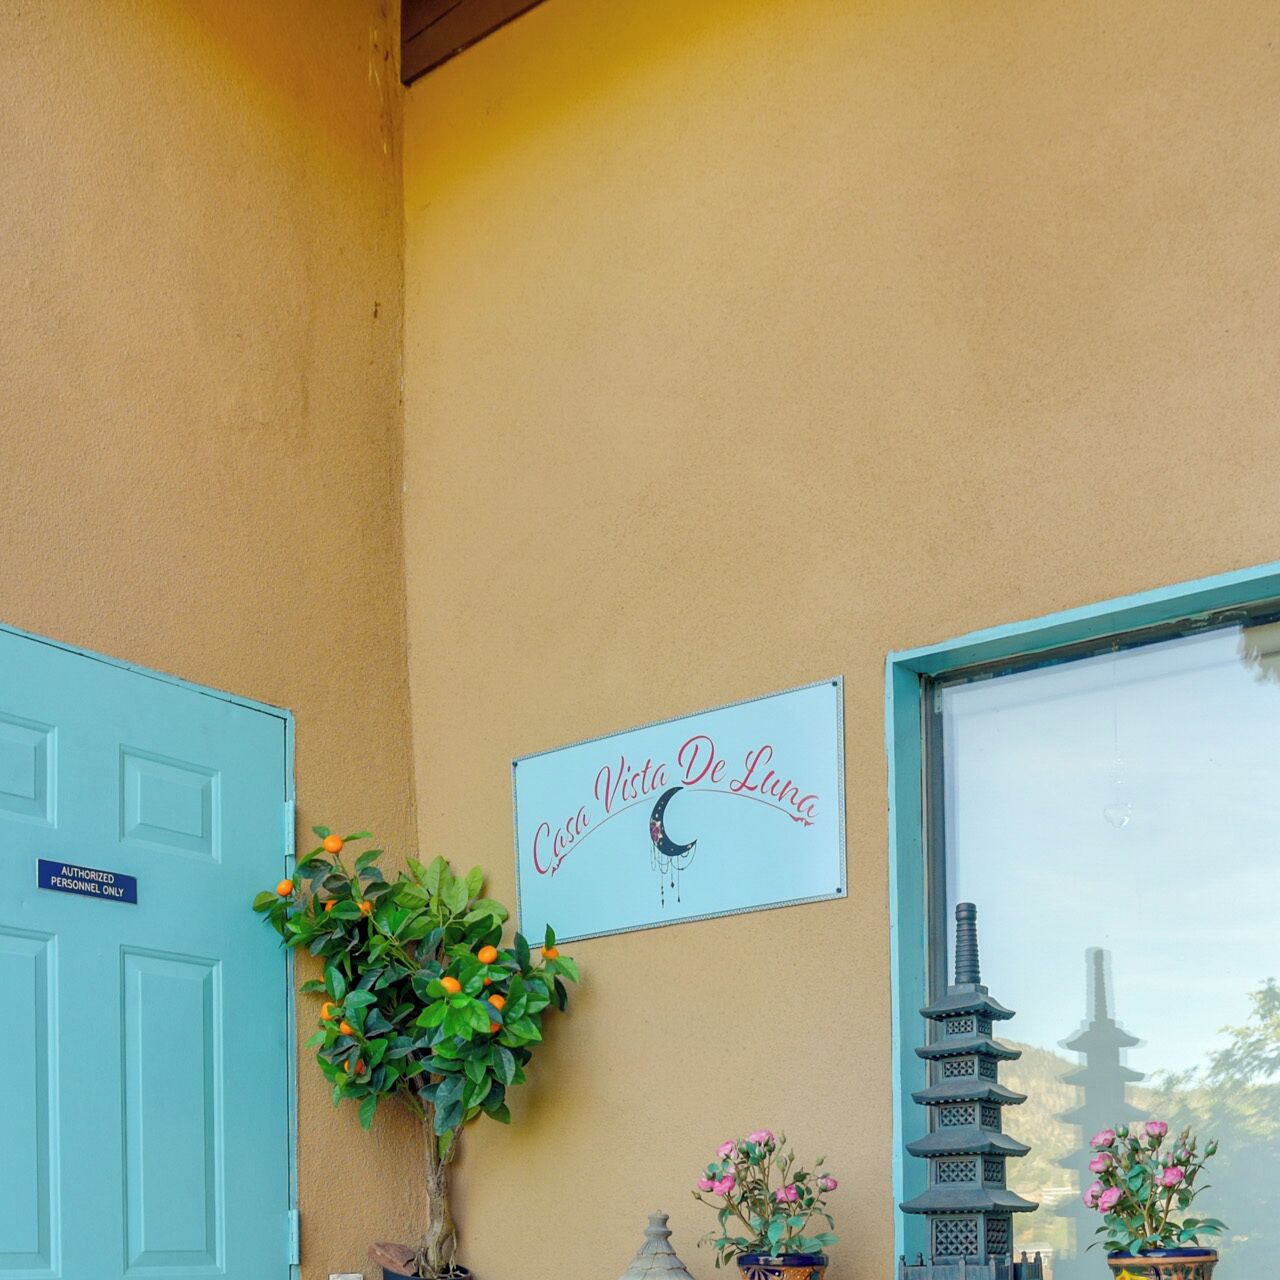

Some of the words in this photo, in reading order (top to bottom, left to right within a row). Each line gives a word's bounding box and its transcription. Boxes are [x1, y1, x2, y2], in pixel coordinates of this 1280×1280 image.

[533, 806, 591, 875] Casa
[594, 756, 668, 813] Vista
[678, 735, 726, 785] De
[729, 745, 819, 817] Luna
[61, 866, 114, 883] AUTHORIZED
[51, 876, 100, 894] PERSONNEL
[102, 885, 124, 897] ONLY
